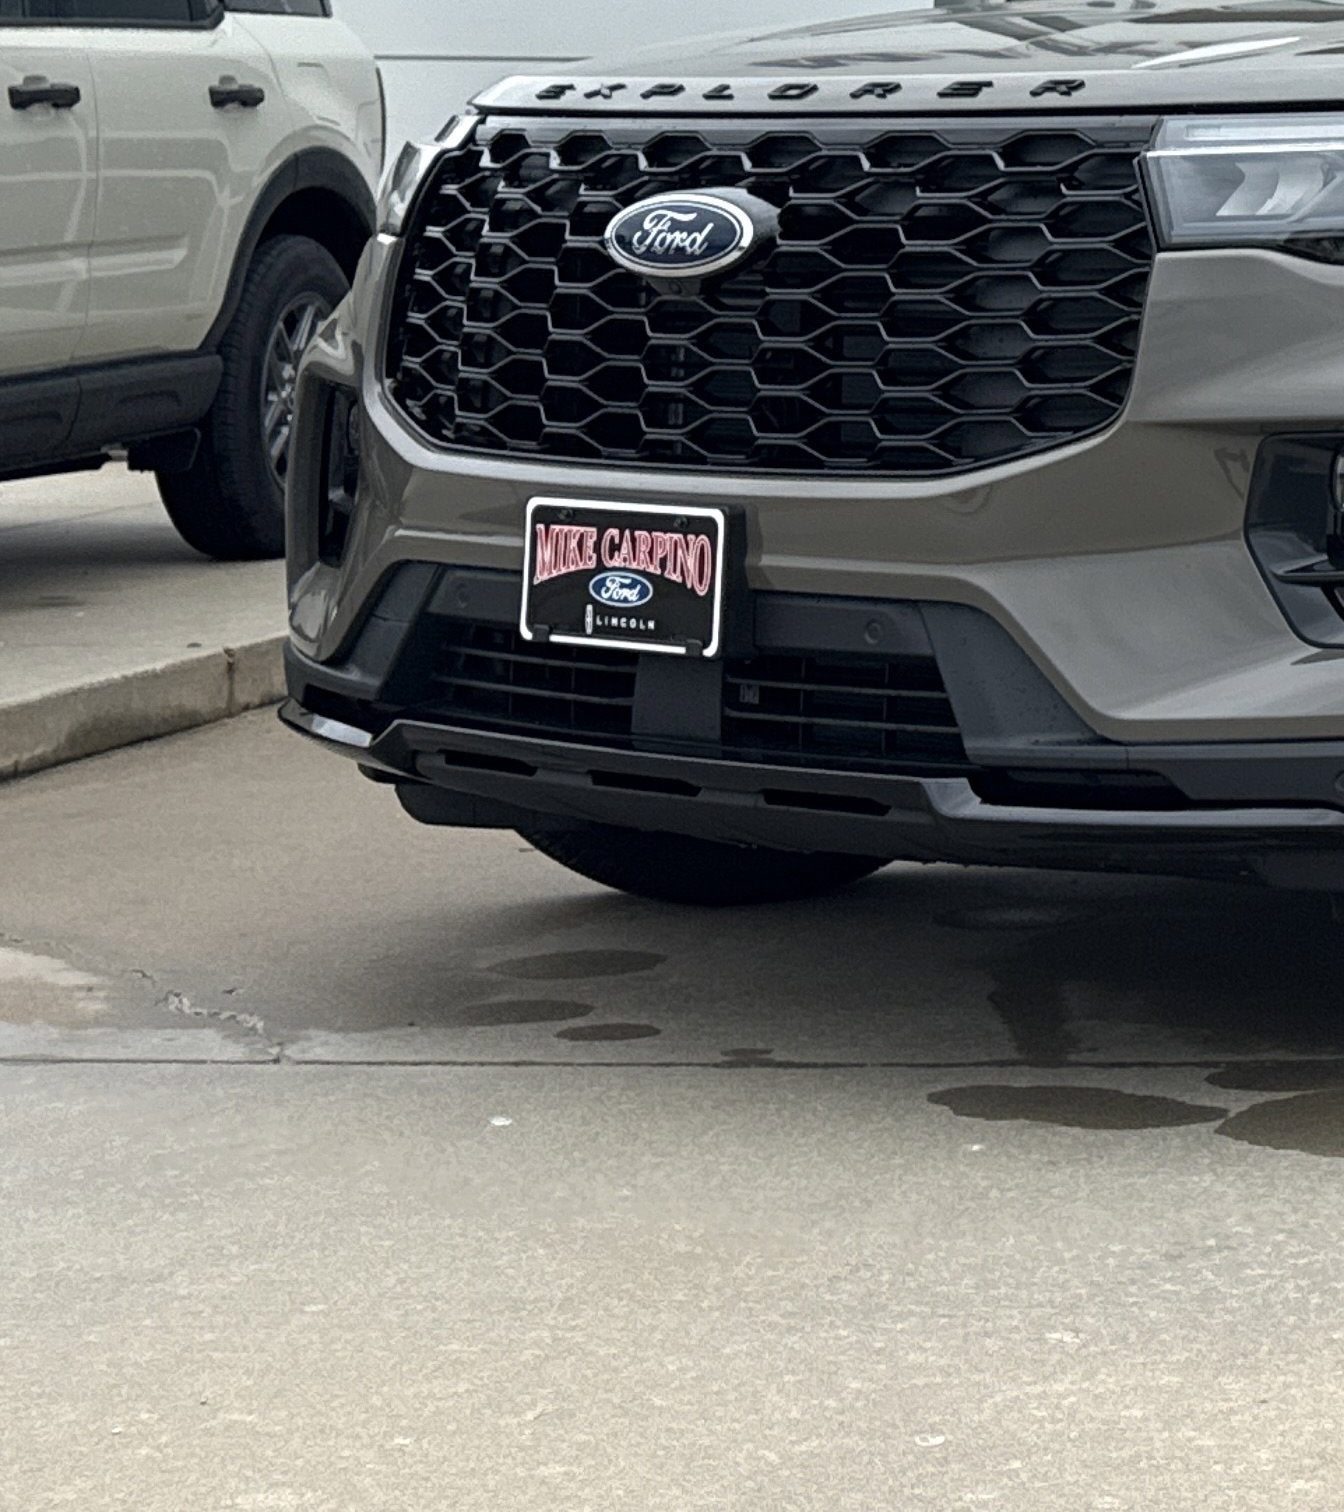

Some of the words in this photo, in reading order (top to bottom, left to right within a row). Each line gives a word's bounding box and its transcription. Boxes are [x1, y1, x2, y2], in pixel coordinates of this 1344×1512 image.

[535, 78, 1086, 100] EXPLORER
[632, 209, 714, 255] Ford
[533, 524, 598, 585] MIKE
[601, 526, 712, 596] CARPINO
[601, 576, 640, 602] Ford
[596, 615, 655, 630] LINCOLN
